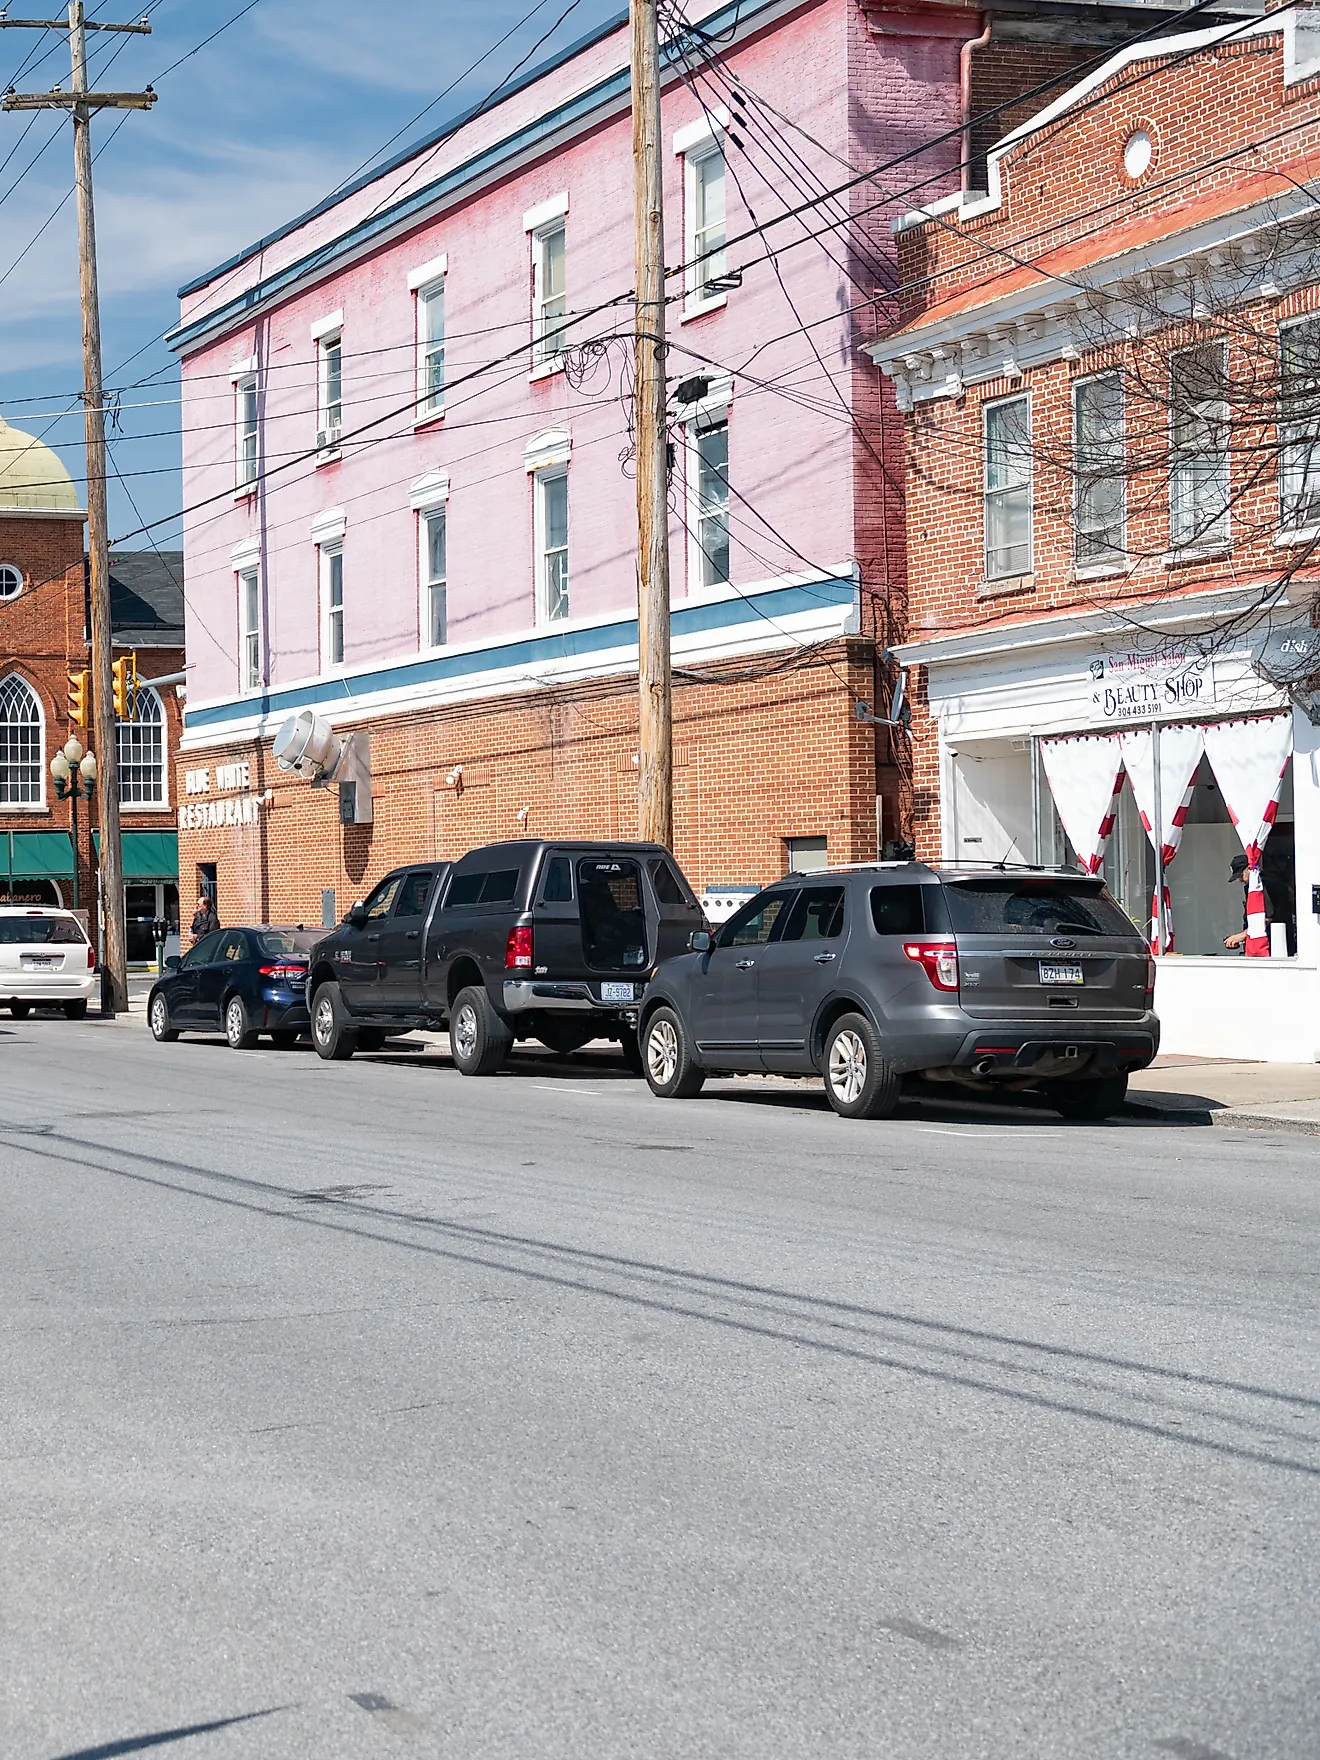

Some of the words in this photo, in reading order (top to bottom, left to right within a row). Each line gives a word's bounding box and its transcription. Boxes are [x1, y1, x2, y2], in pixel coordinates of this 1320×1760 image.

[1108, 656, 1124, 674] San
[1127, 650, 1158, 675] Miguel
[1161, 648, 1186, 667] Salon
[1092, 692, 1101, 704] &
[1117, 706, 1131, 717] 304
[1132, 704, 1146, 715] 433
[1147, 703, 1162, 713] 5191
[178, 797, 261, 829] RESTAURANT
[1063, 968, 1081, 979] 174
